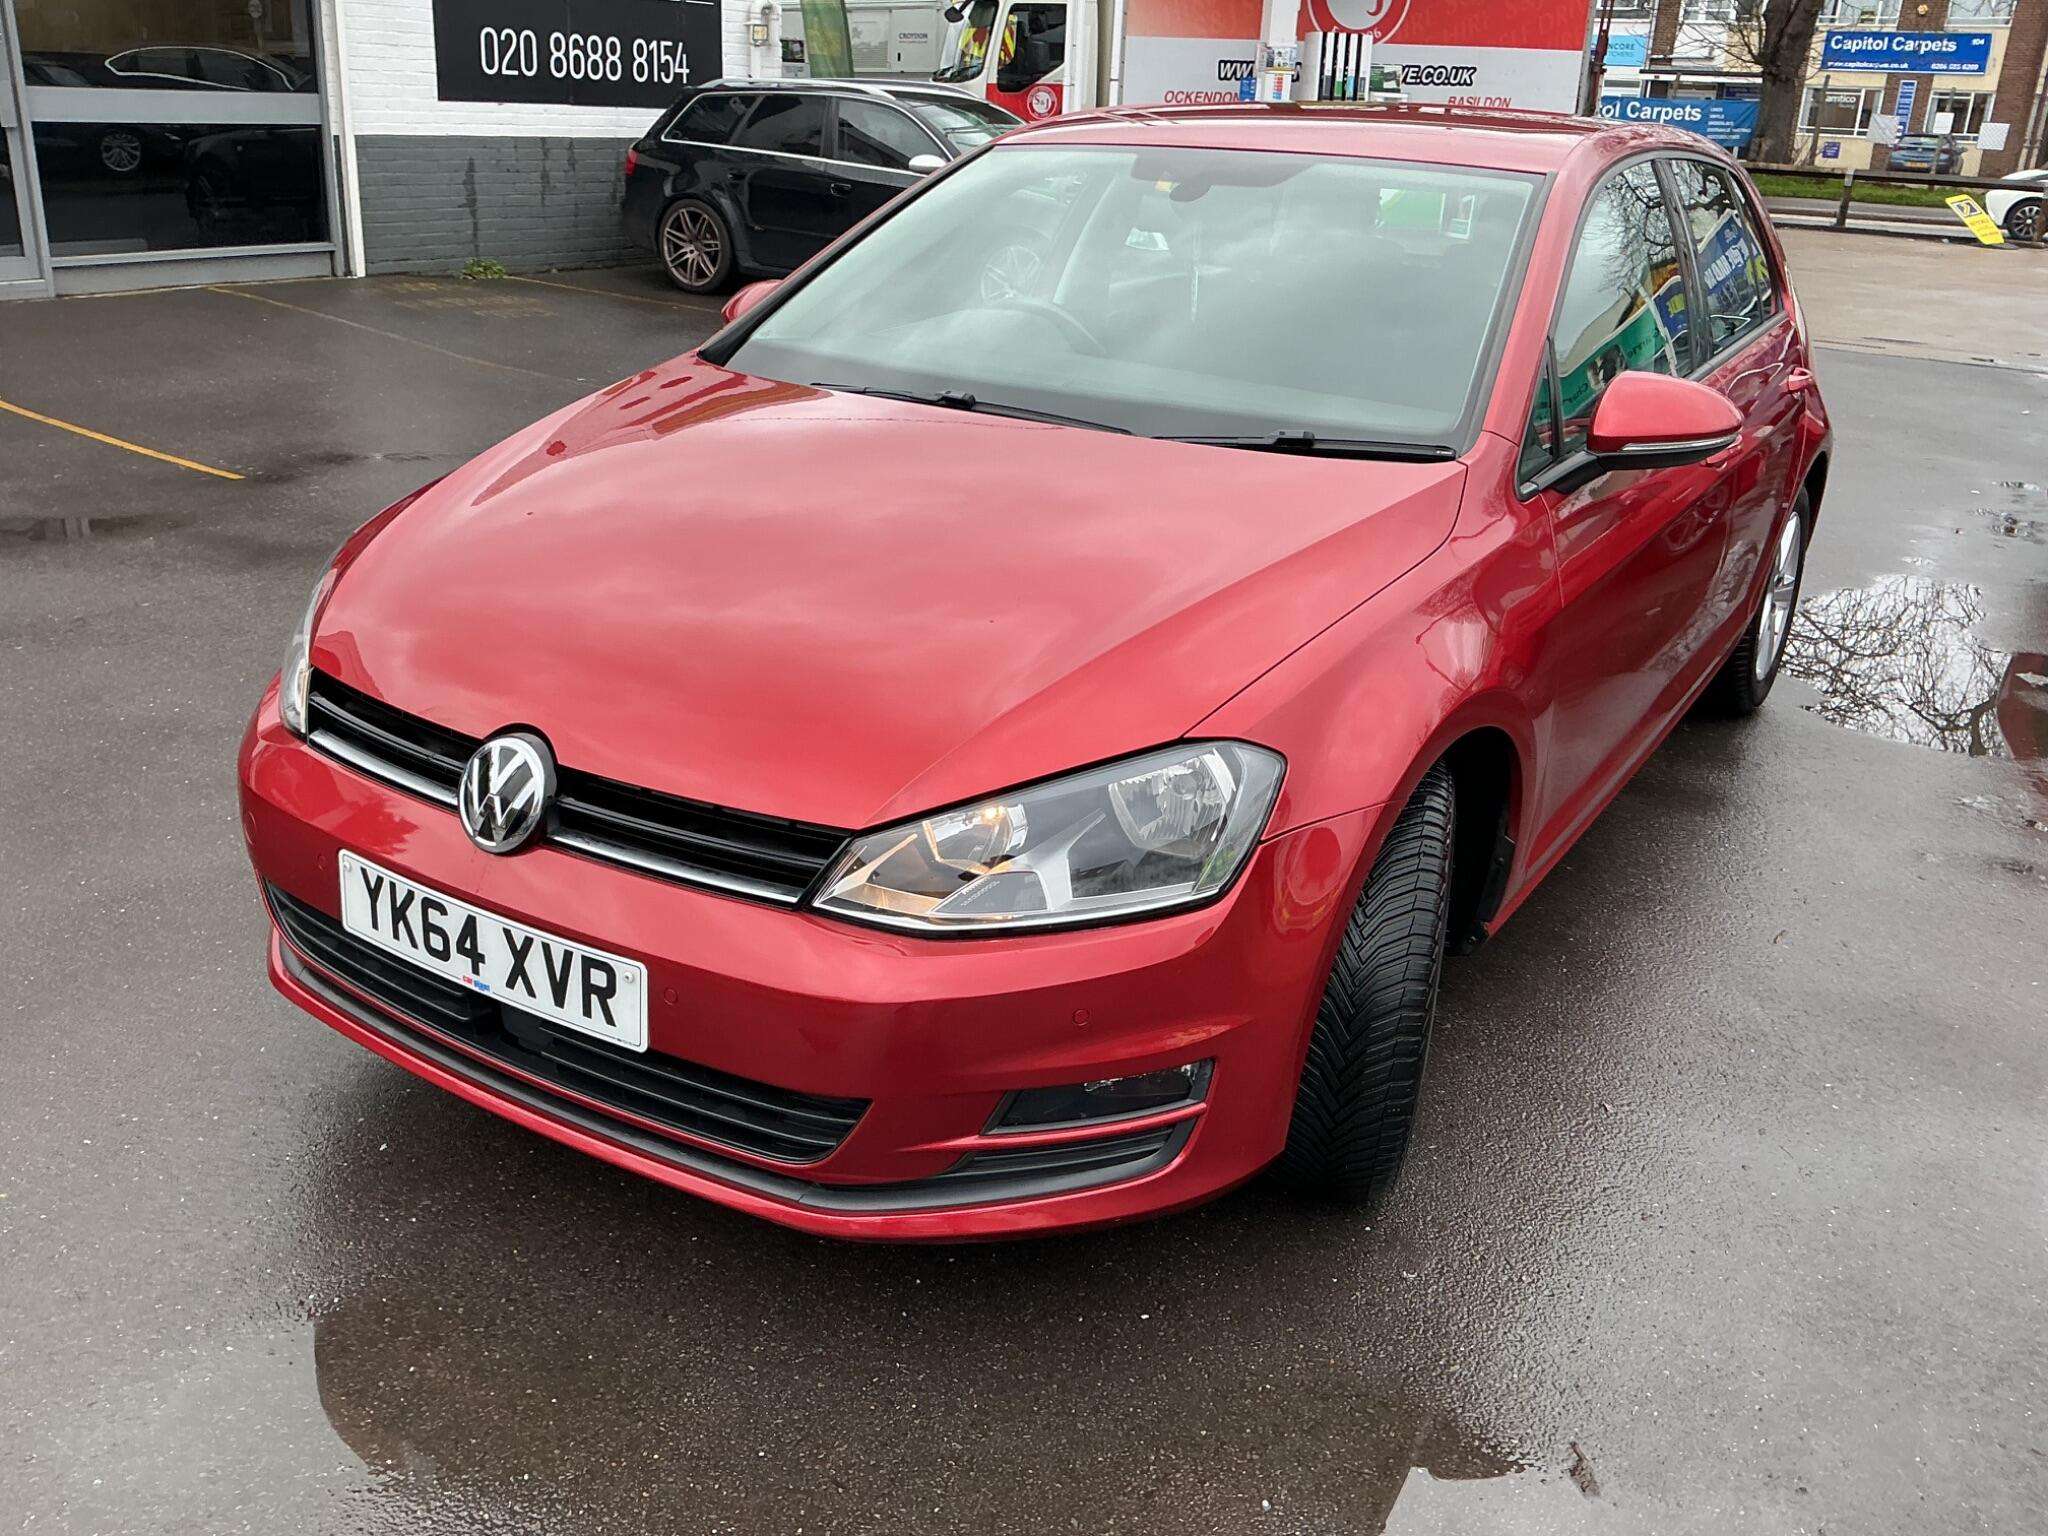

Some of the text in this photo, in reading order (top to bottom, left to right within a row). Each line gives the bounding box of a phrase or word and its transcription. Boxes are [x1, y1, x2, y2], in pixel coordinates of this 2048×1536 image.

[898, 32, 928, 40] CROYDON
[1830, 35, 1957, 54] Capitol Carpets
[480, 26, 690, 84] 020 8688 8154
[1164, 90, 1241, 104] OCKENDON
[1825, 94, 1857, 103] amtico
[1626, 101, 1702, 124] Carpets
[361, 866, 618, 1027] YK64 XVR
